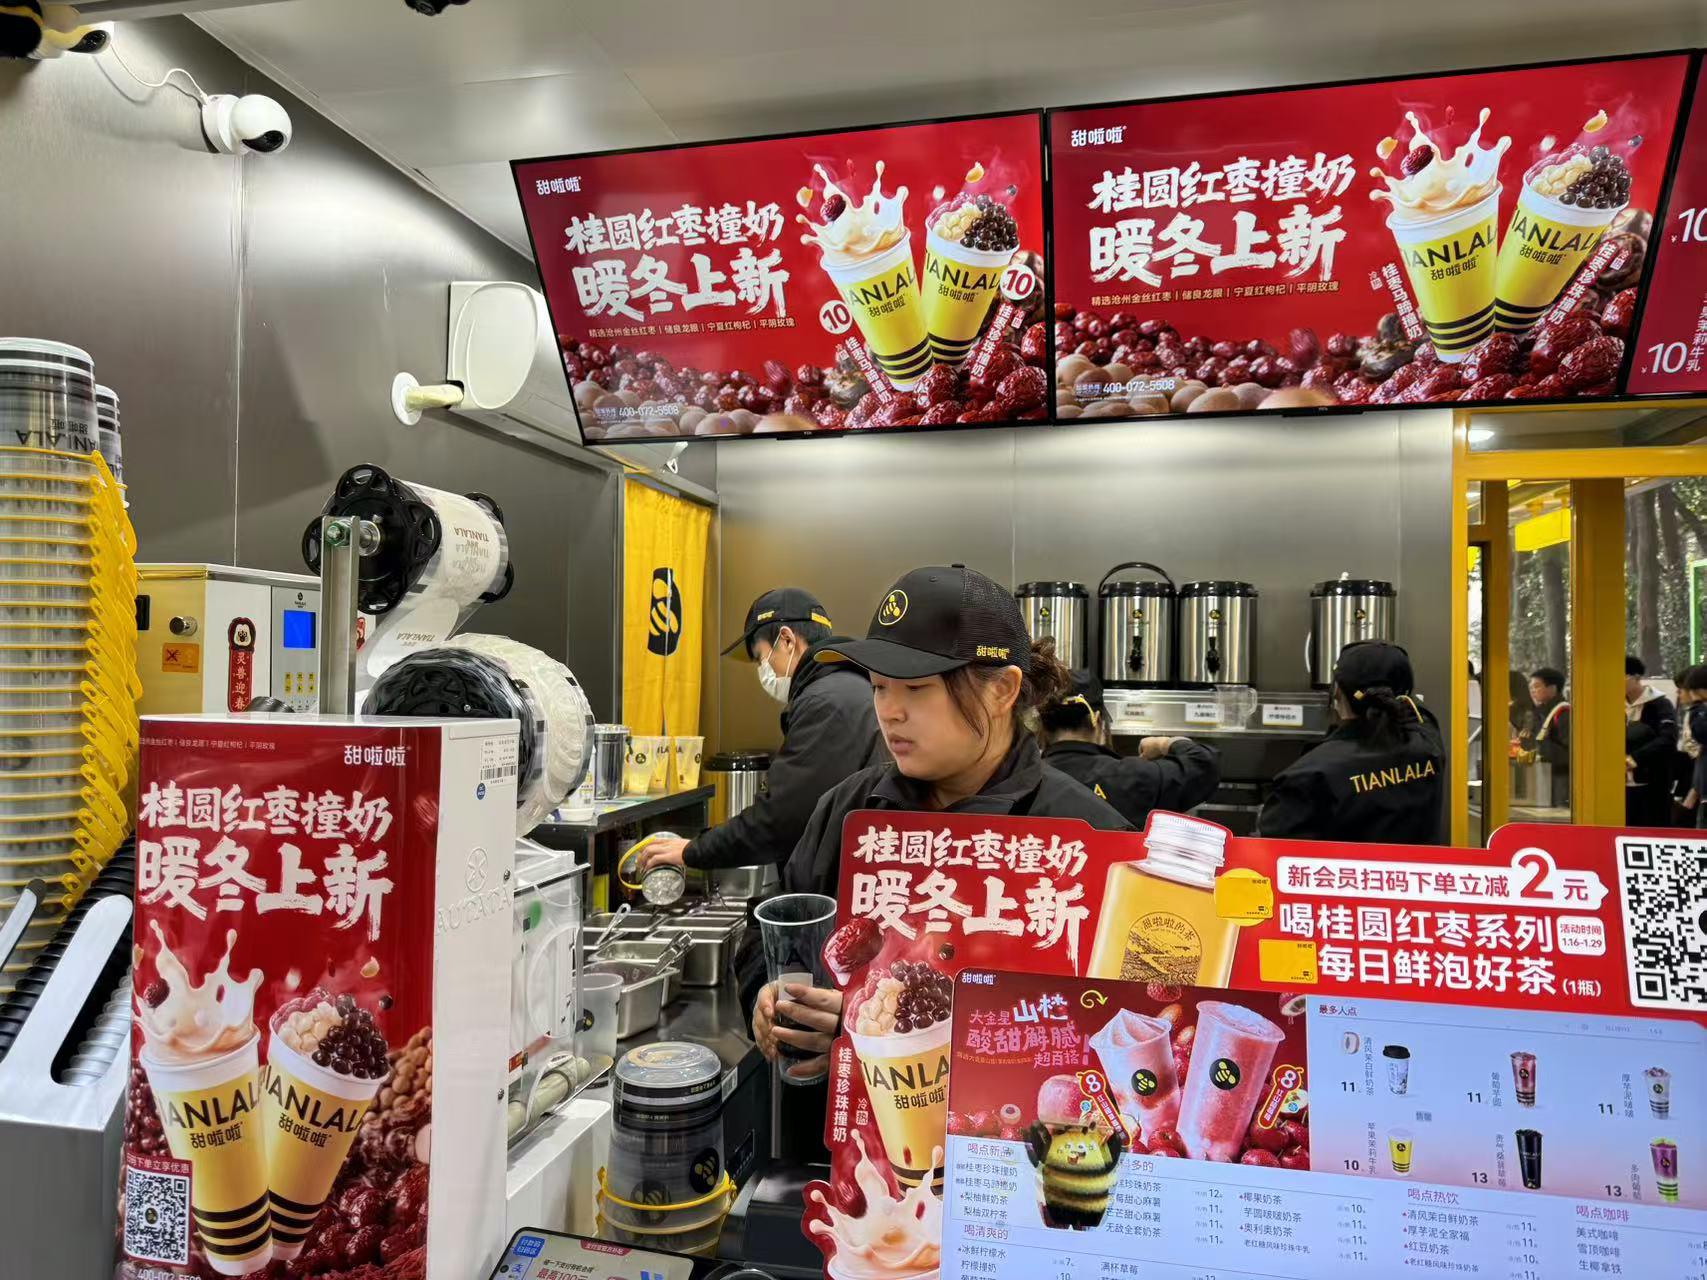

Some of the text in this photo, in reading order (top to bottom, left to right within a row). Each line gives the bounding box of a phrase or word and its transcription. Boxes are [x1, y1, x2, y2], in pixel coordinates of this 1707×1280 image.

[1071, 126, 1126, 146] 甜啦啦
[536, 176, 581, 196] 甜啦啦
[1087, 152, 1356, 213] 桂圆红枣撞奶
[565, 200, 784, 254] 桂圆红枣撞奶
[1089, 204, 1347, 288] 暖冬上新
[1519, 244, 1566, 265] 甜啦啦
[1430, 254, 1479, 281] 甜啦啦
[571, 248, 790, 323] 暖冬上新
[938, 284, 978, 303] 甜啦啦
[1091, 281, 1339, 306] 精选沧州金丝红枣 储良龙眼 宁夏红枸杞 平阴玫瑰
[869, 295, 907, 317] 甜啦啦
[1686, 292, 1707, 372] 果茉莉牛乳
[344, 744, 407, 766] 甜啦啦
[1350, 759, 1436, 794] TIANLALA
[139, 780, 393, 847] 桂圆红枣撞奶
[853, 824, 1089, 881] 桂圆红枣撞奶
[139, 835, 394, 942] 暖冬上新
[851, 869, 1090, 977] 暖冬上新
[1279, 902, 1554, 953] 喝桂圆红枣系列
[1560, 923, 1602, 935] 活动时间
[1562, 937, 1602, 949] 1.16-1.29
[962, 972, 997, 985] 甜啦啦
[1318, 944, 1602, 997] 每日鲜泡好茶 (1瓶)
[969, 993, 1069, 1026] 大金星 山楂
[1319, 1004, 1358, 1017] 最多人点
[966, 1022, 1081, 1055] 酸甜解腻
[1086, 1074, 1101, 1093] 8
[1283, 1070, 1297, 1089] 8
[1341, 1081, 1356, 1093] 11
[833, 1047, 852, 1143] 桂枣珍珠撞奶
[894, 1084, 946, 1110] 甜啦啦
[1467, 1091, 1482, 1104] 11
[1598, 1103, 1614, 1115] 11
[191, 1122, 244, 1149] 甜啦啦
[278, 1113, 333, 1148] 甜啦啦
[967, 1143, 1012, 1158] 喝点新品
[1344, 1159, 1360, 1171] 10
[1472, 1172, 1488, 1184] 13
[1408, 1188, 1460, 1205] 喝点热饮
[1605, 1184, 1622, 1197] 13
[1576, 1205, 1629, 1222] 喝点咖啡
[964, 1224, 1009, 1240] 喝清爽的
[1576, 1227, 1619, 1240] 美式咖啡
[1408, 1241, 1450, 1255] 红豆奶茶
